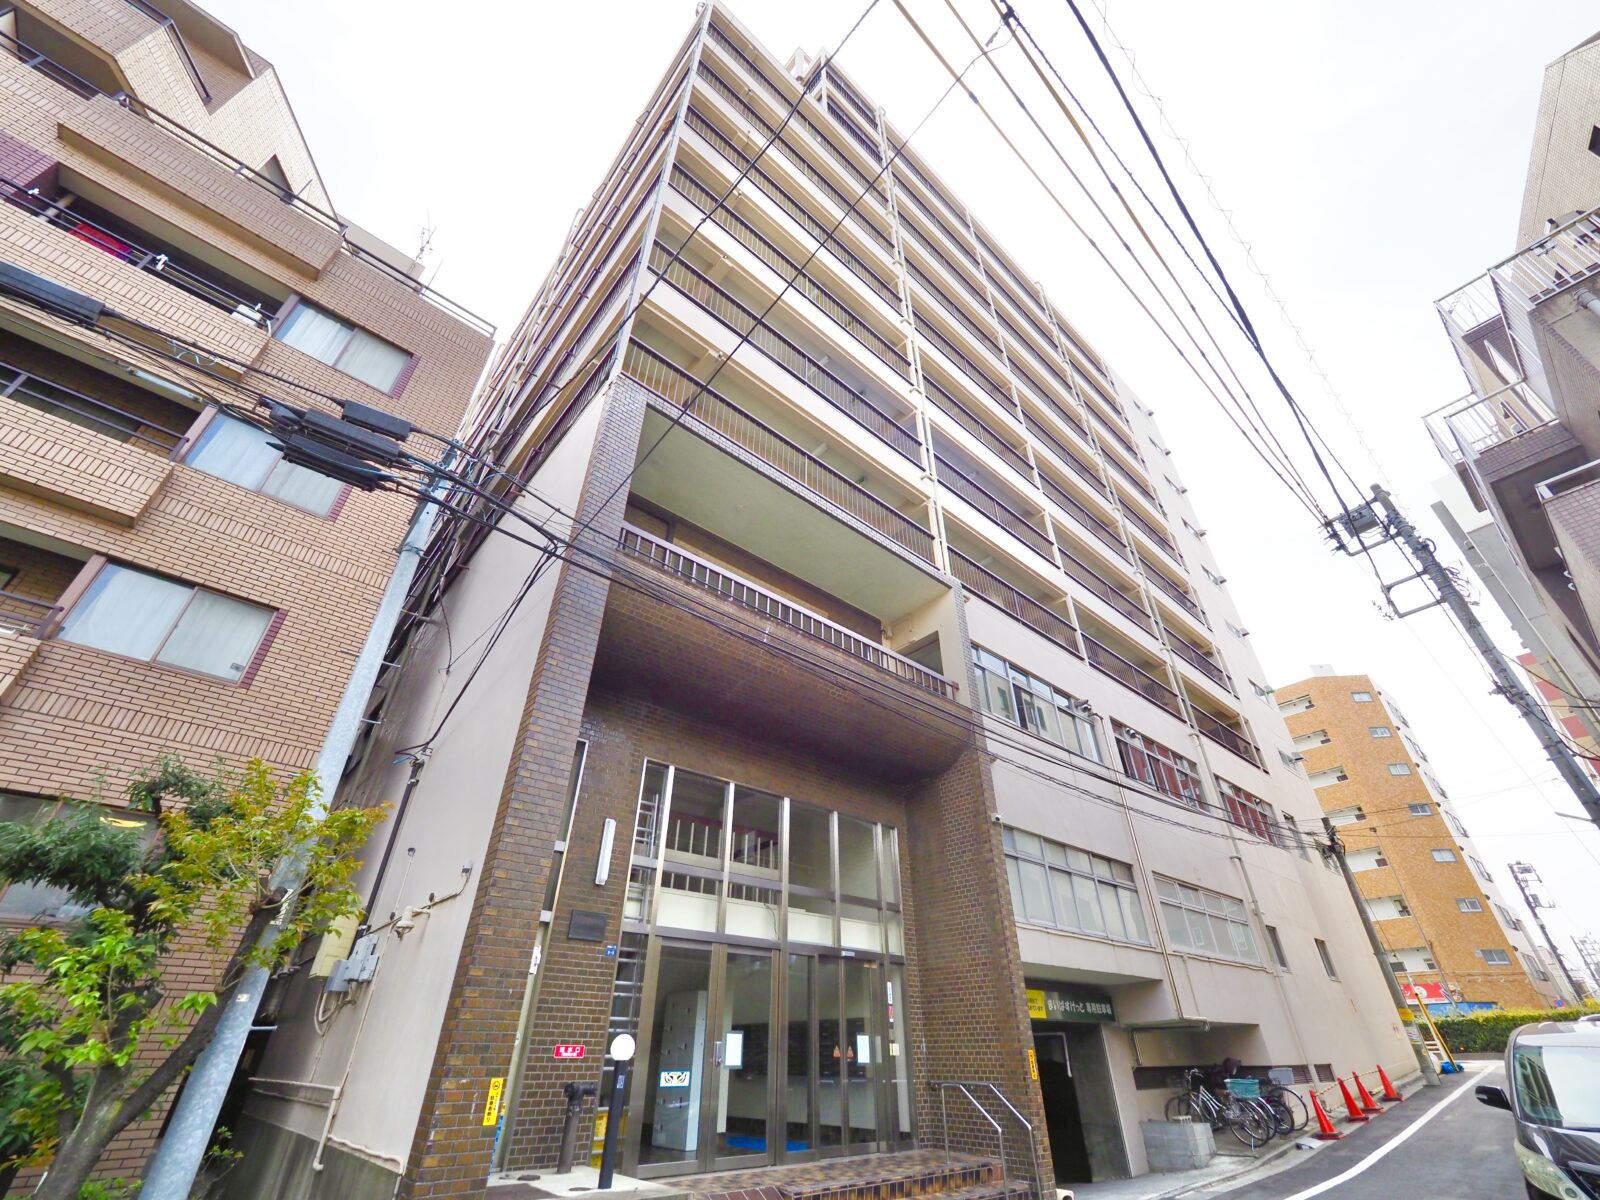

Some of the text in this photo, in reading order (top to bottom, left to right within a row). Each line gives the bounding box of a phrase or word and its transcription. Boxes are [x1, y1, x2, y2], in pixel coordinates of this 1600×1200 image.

[1047, 1000, 1085, 1013] まいばすけっと
